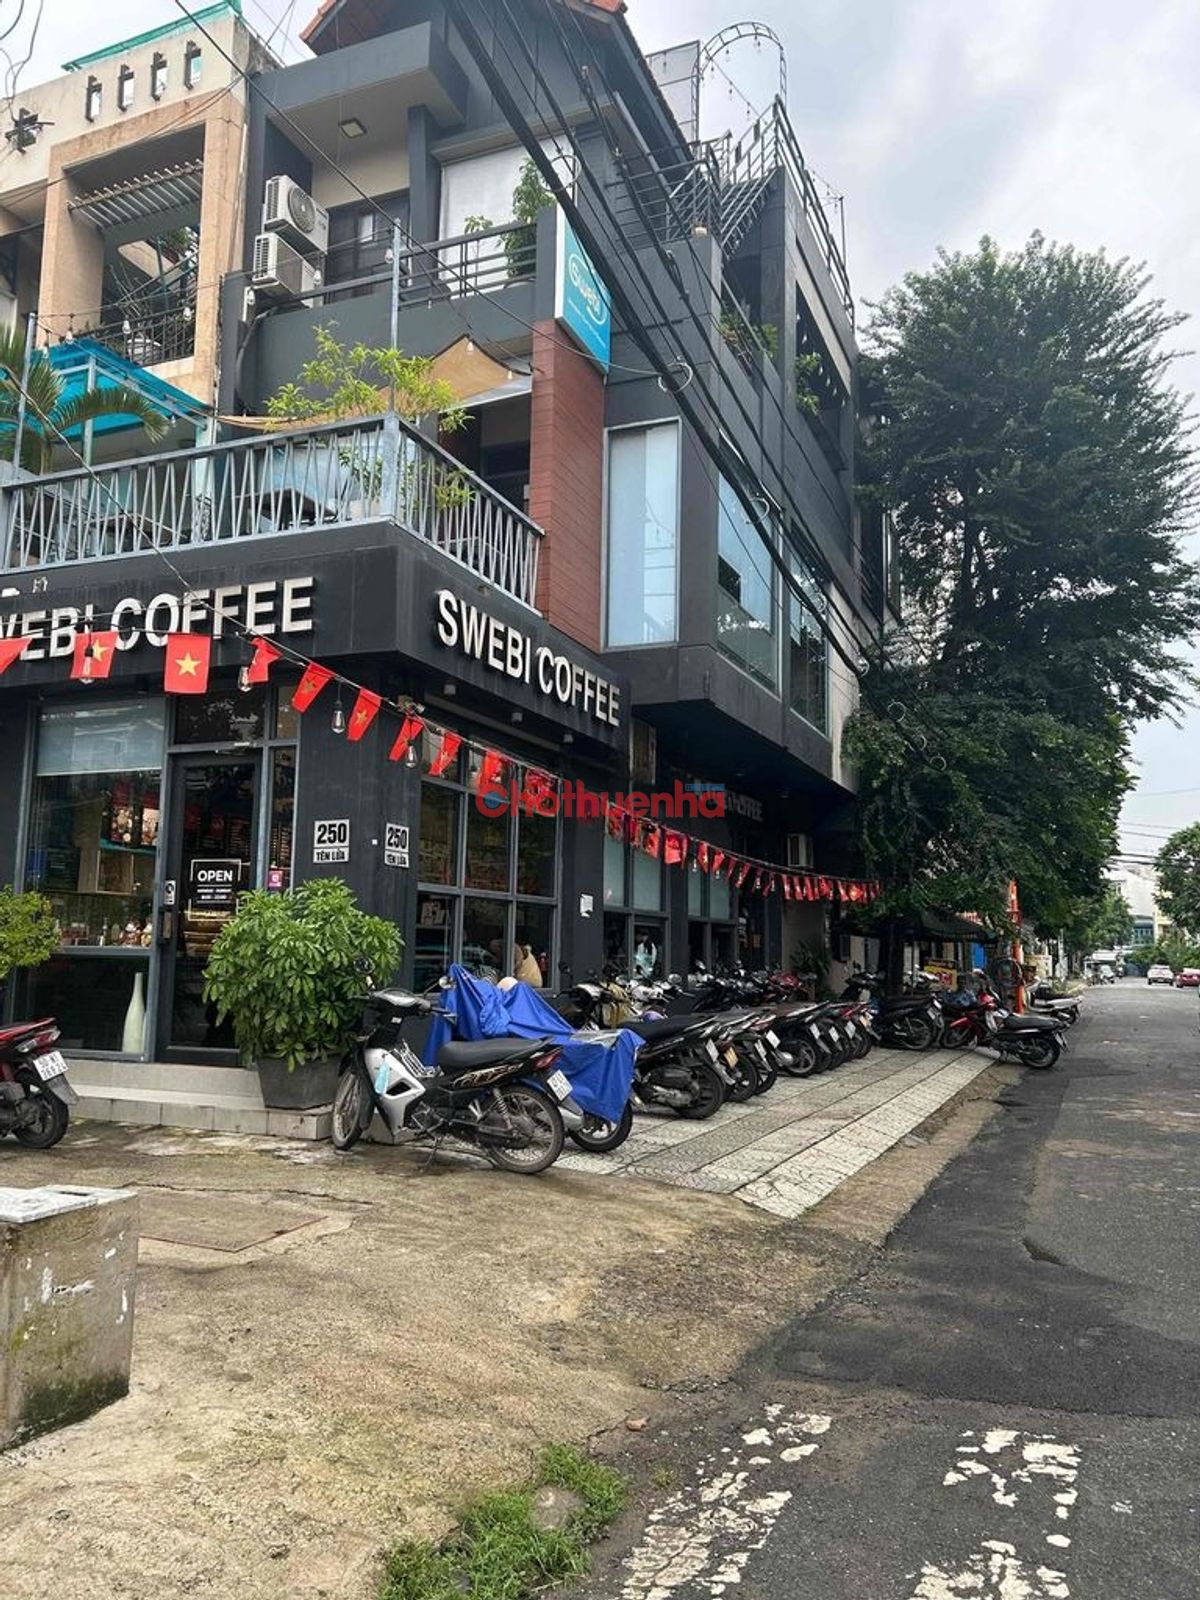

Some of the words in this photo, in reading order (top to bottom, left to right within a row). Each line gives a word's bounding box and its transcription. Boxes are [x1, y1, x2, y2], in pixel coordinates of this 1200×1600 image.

[112, 577, 314, 650] COFFEE
[438, 589, 531, 684] SWEBI
[537, 647, 620, 727] COFFEE
[317, 823, 347, 844] 250
[388, 827, 407, 849] 250
[197, 870, 233, 882] OPEN
